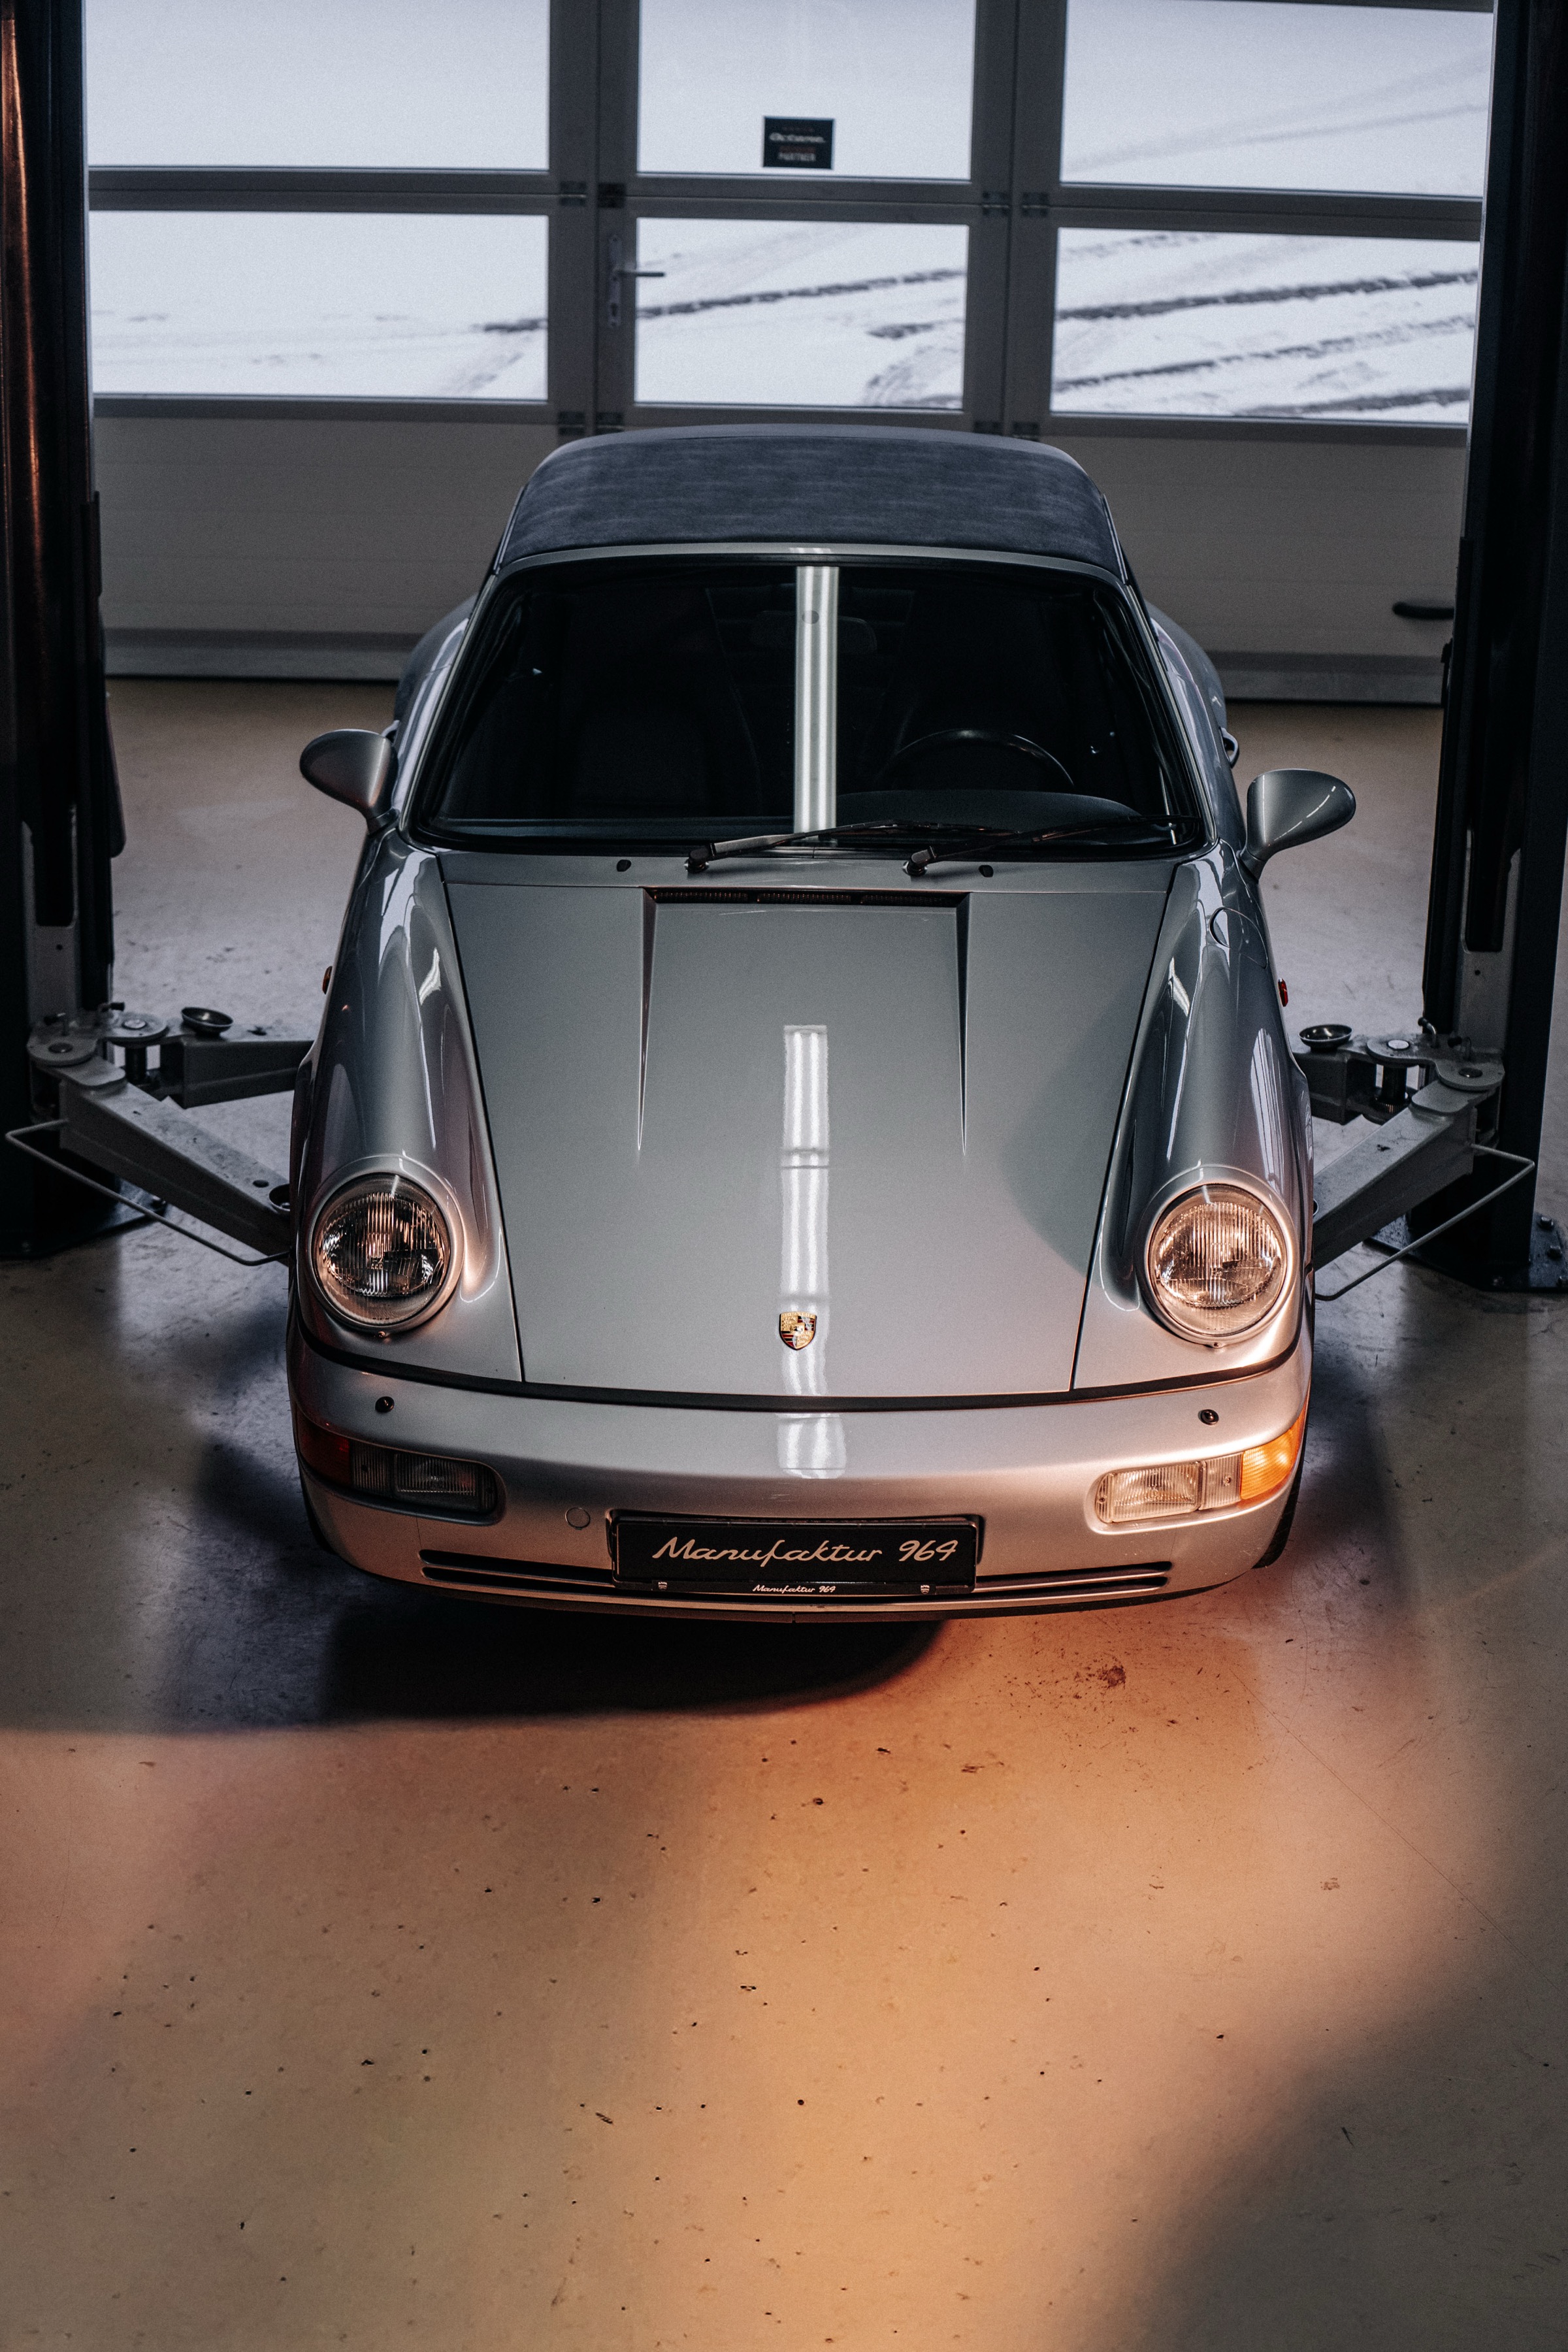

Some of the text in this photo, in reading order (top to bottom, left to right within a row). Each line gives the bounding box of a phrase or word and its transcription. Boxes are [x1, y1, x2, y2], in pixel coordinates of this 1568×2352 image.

[652, 1537, 958, 1567] Manufaktur 964
[753, 1584, 815, 1593] Manufaktur
